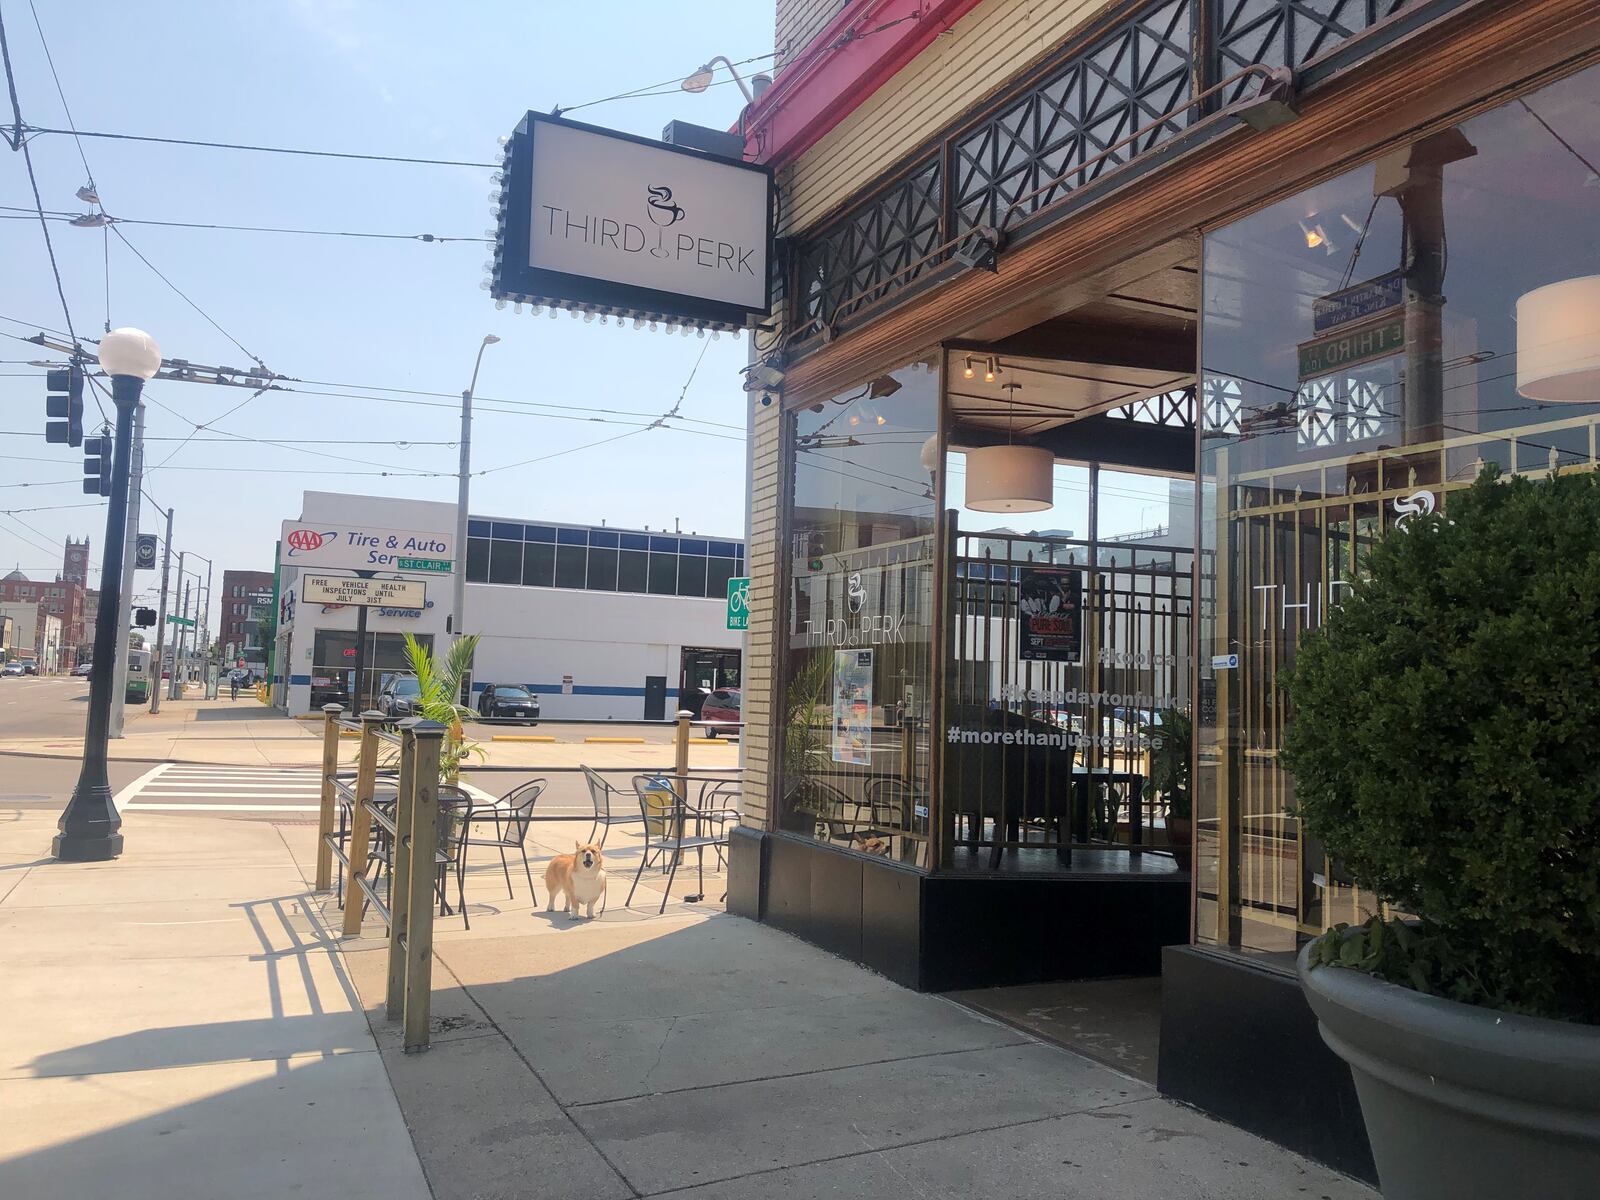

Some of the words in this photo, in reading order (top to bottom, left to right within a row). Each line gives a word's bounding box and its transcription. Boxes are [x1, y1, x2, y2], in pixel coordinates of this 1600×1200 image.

[542, 204, 646, 254] THIRD
[676, 233, 755, 277] PERK
[289, 531, 322, 550] AAA
[347, 532, 379, 547] Tire
[385, 535, 399, 549] &
[403, 537, 446, 553] Auto
[404, 560, 414, 568] ST
[417, 561, 441, 570] CLAIR
[312, 579, 328, 587] FREE
[342, 581, 369, 589] VEHICLE
[381, 583, 406, 591] HEALTH
[322, 587, 366, 596] INSPECTIONS
[375, 590, 394, 598] UNTIL
[378, 608, 421, 618] Service
[730, 616, 741, 627] BIKE
[803, 618, 848, 646] THIRD
[862, 614, 905, 645] PERK
[947, 725, 1164, 750] #morethanjustcoffee
